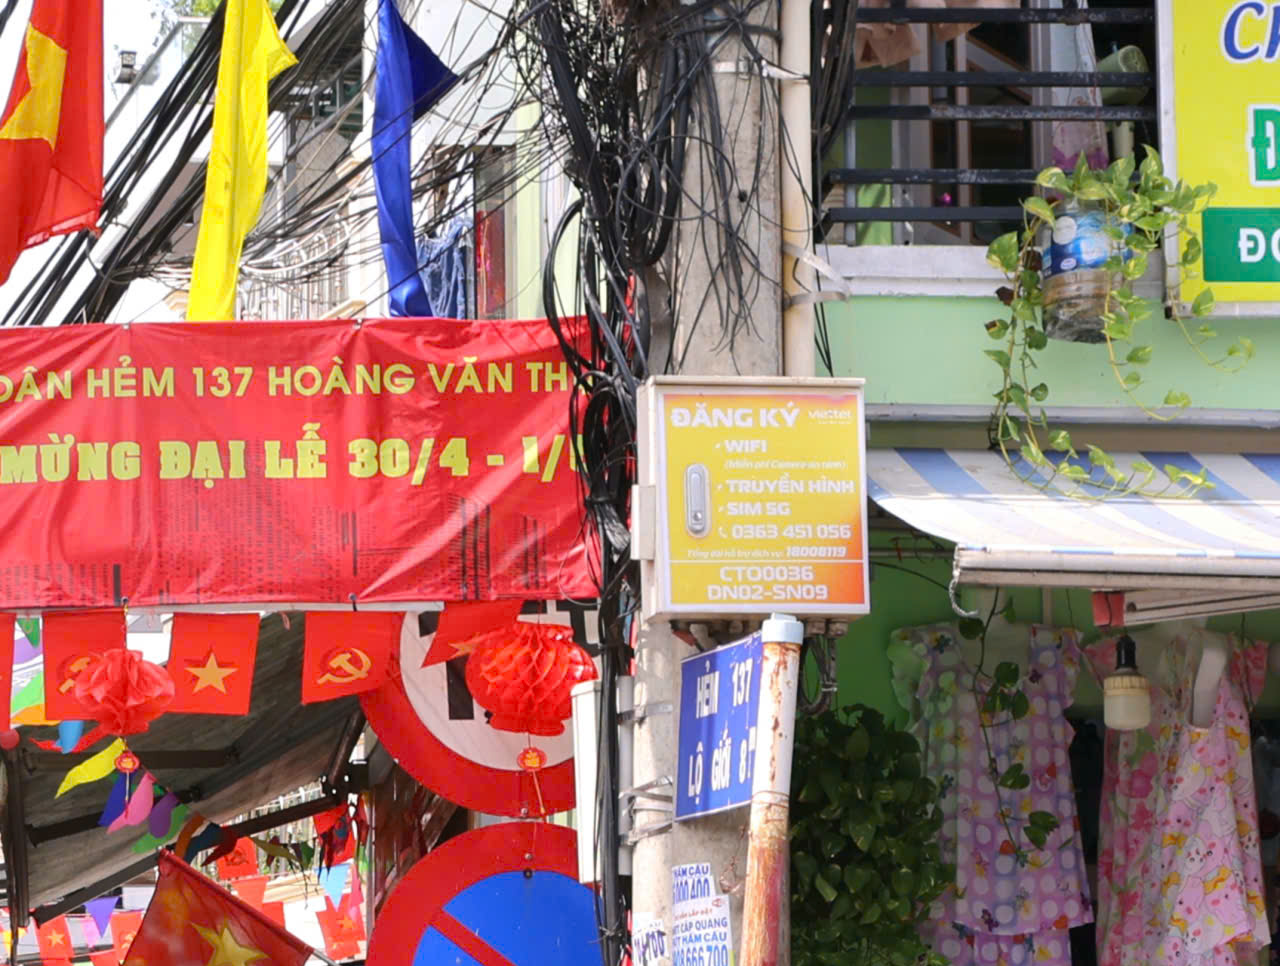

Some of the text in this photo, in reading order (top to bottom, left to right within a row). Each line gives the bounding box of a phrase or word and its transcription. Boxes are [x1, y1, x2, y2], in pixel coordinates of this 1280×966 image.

[87, 355, 175, 399] HẺM
[192, 366, 253, 397] 137
[268, 356, 416, 396] HOÀNG
[427, 356, 513, 393] VĂN
[670, 401, 800, 428] ĐĂNG KÝ
[0, 433, 141, 485] MỪNG
[160, 441, 246, 488] ĐẠI
[264, 422, 327, 479] LỄ
[347, 437, 470, 485] 30/4
[725, 440, 767, 452] WIFI
[727, 472, 856, 494] TRUYỀN HÌNH
[727, 502, 762, 516] SIM
[783, 524, 813, 539] 451
[817, 524, 852, 539] 056
[707, 585, 828, 600] DN02-SN09
[732, 658, 753, 707] 137
